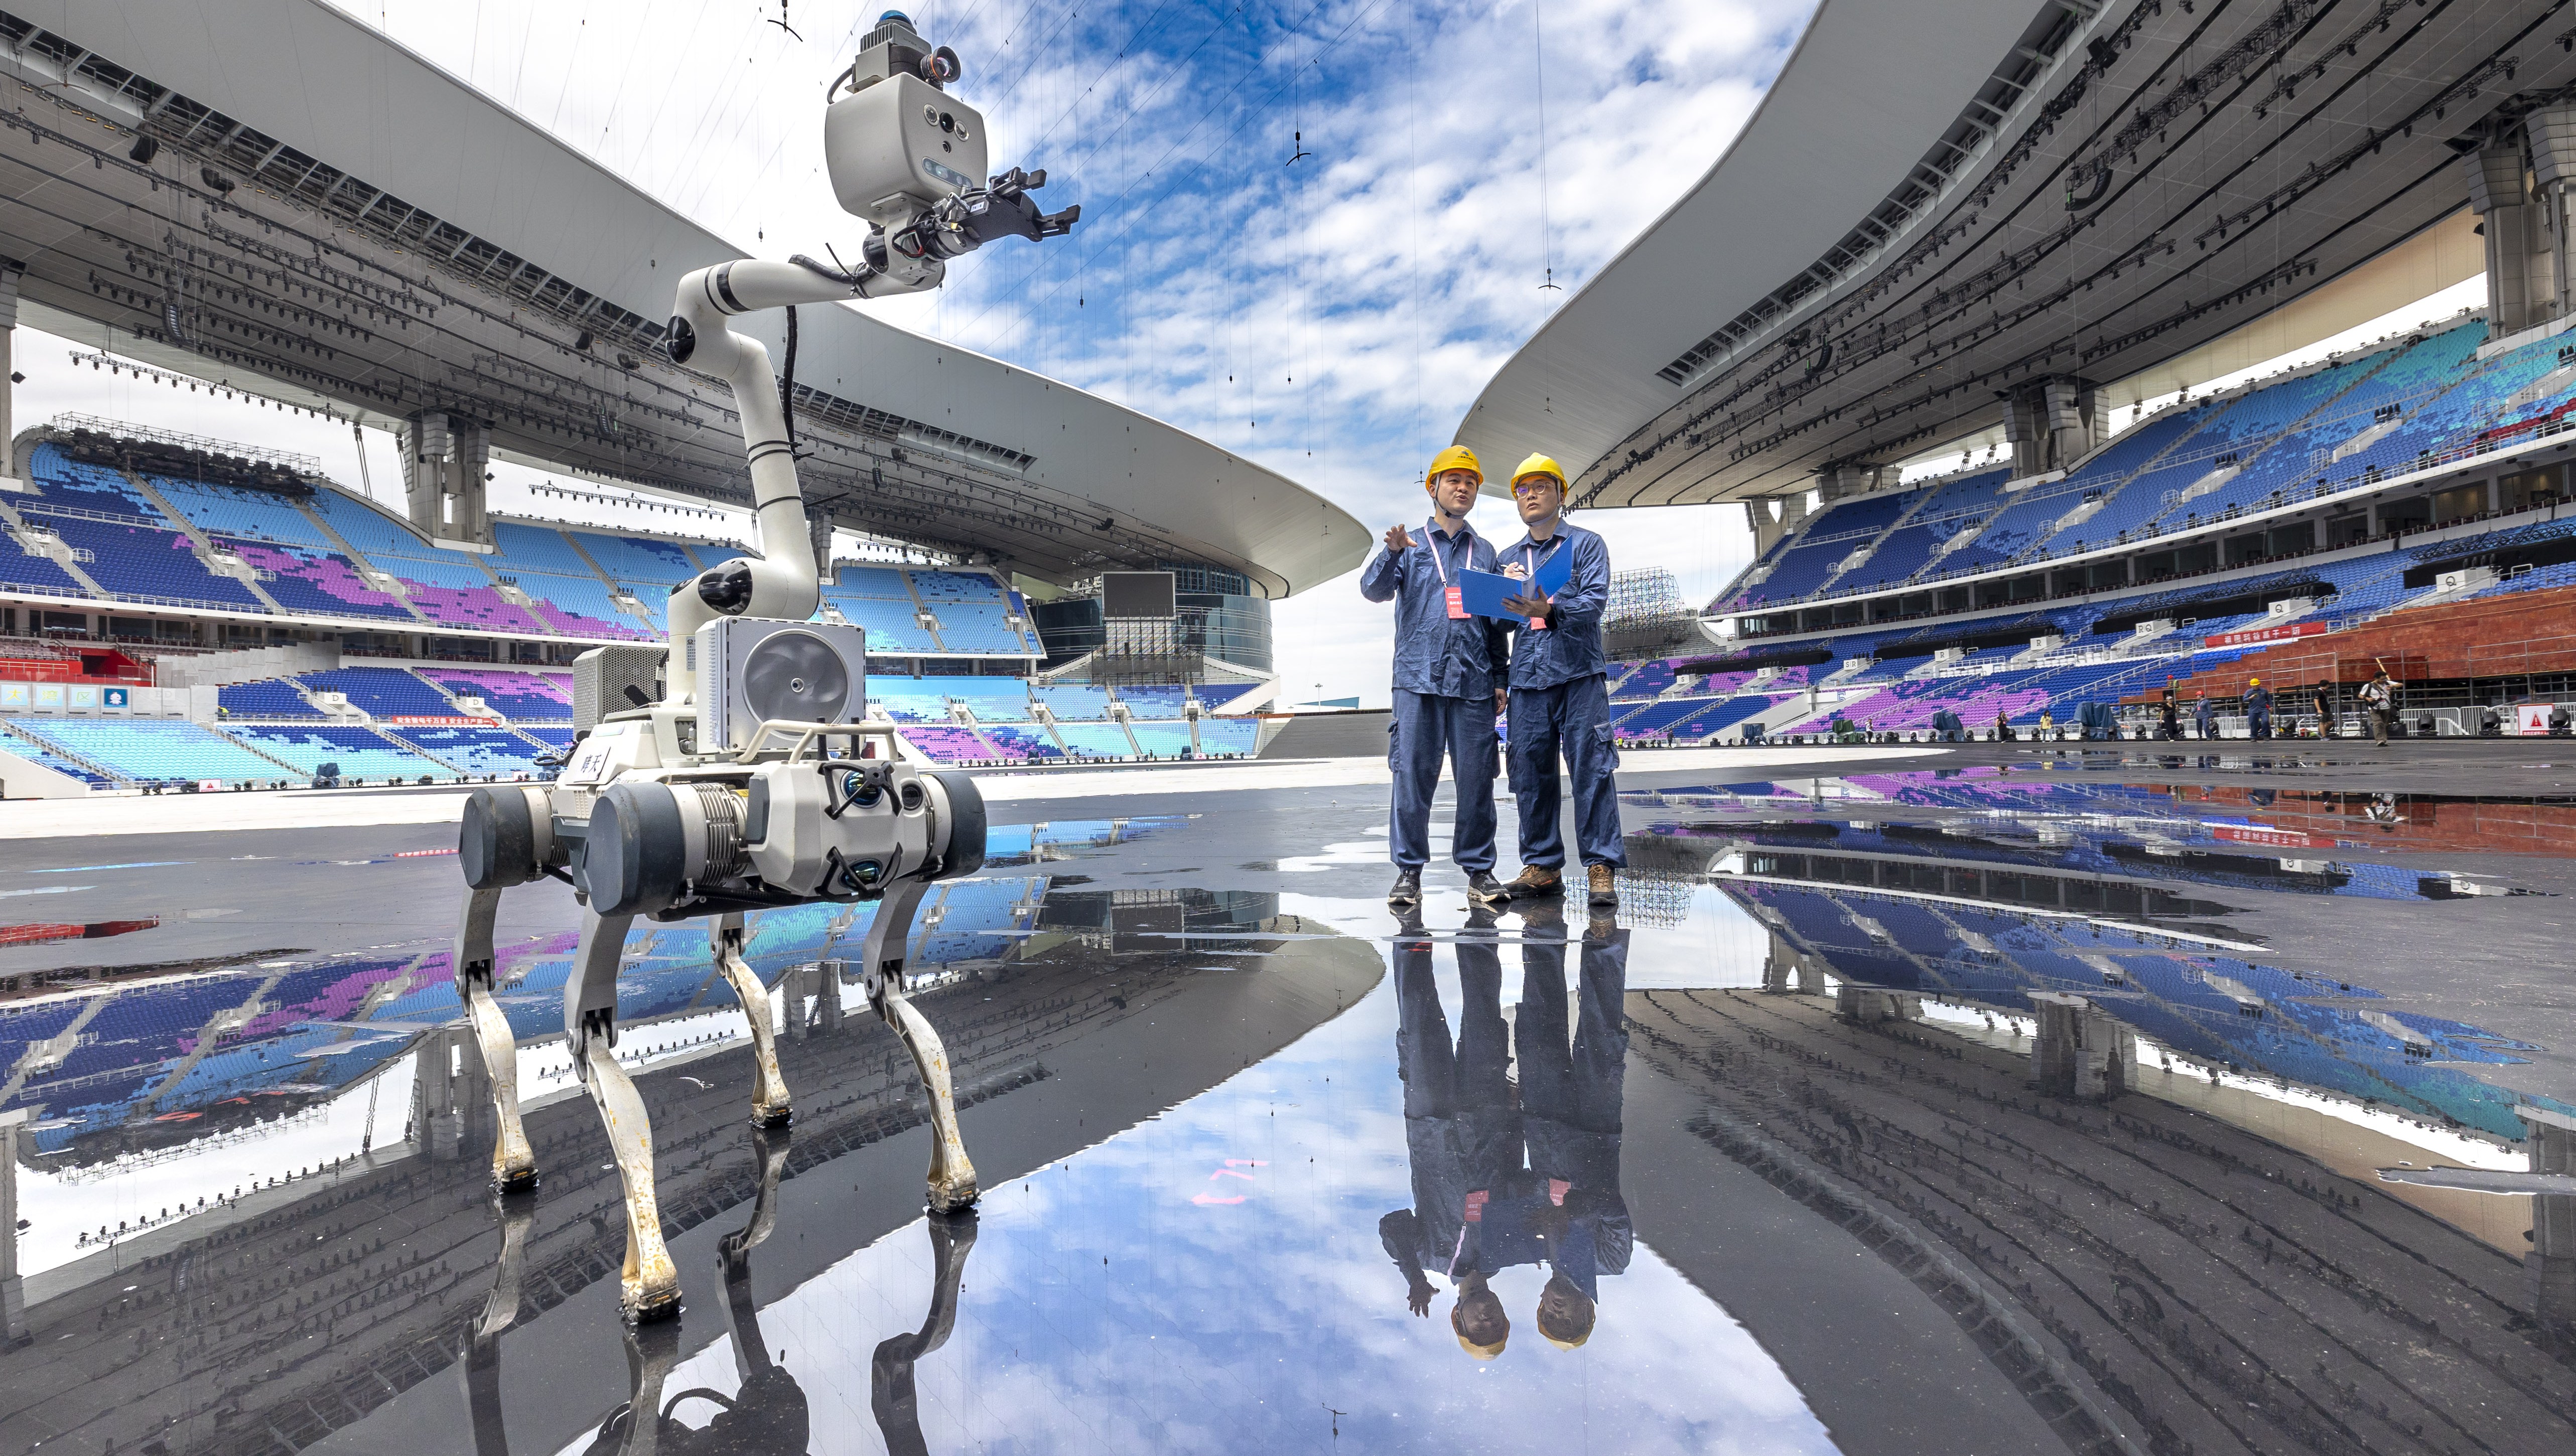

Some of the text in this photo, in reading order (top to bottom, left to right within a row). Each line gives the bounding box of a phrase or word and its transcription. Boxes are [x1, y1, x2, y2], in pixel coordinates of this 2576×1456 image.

[2446, 575, 2457, 587] Q
[2275, 604, 2283, 613] Q
[2138, 624, 2152, 633] R Q
[2224, 627, 2300, 644] 祖国利益高于一切
[5, 688, 91, 702] 大湾区
[580, 754, 602, 773] 哮天
